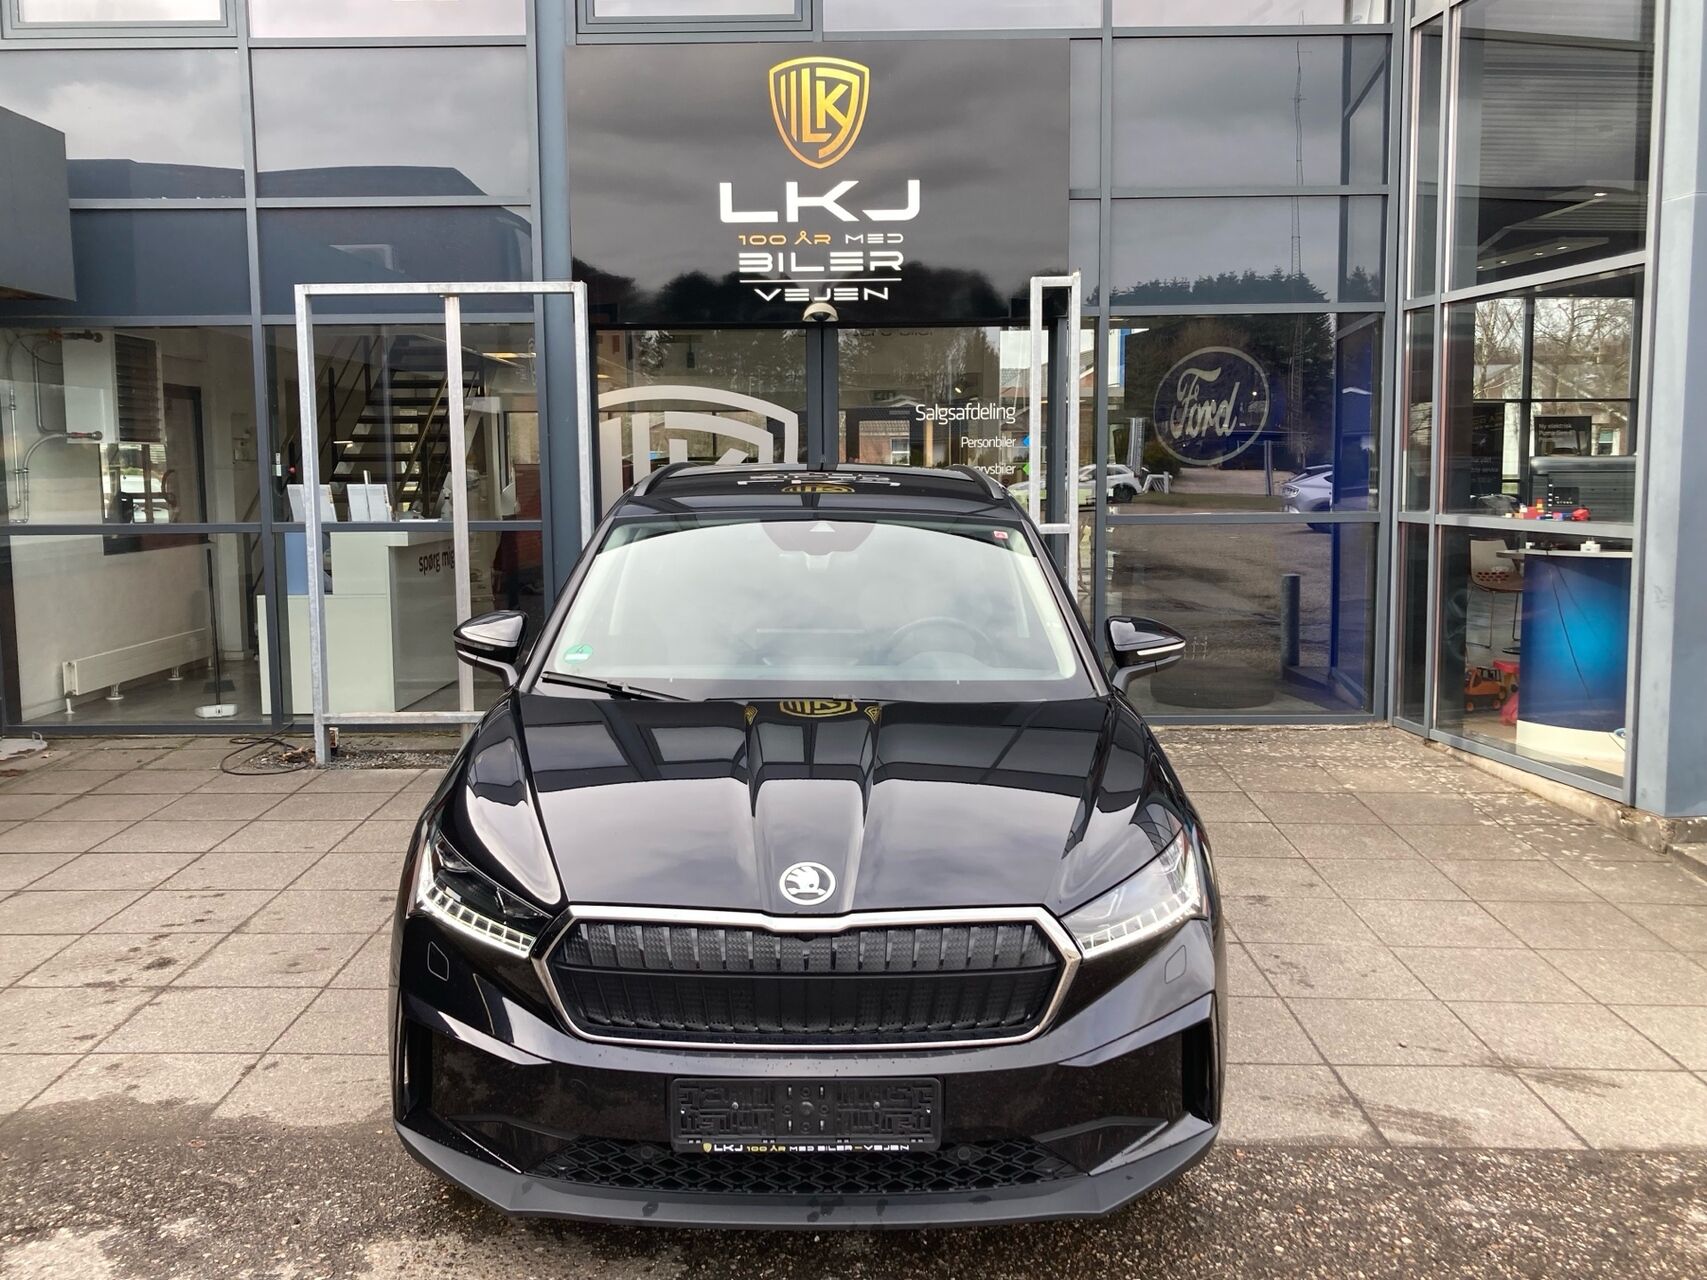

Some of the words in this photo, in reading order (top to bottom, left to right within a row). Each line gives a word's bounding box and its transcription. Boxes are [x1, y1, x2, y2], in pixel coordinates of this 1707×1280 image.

[719, 179, 921, 224] LKJ
[738, 234, 787, 246] 100
[794, 230, 832, 245] ÅR
[845, 233, 904, 245] MED
[738, 251, 904, 273] BILER
[753, 287, 889, 302] VEJEN
[915, 402, 1016, 425] Salgsafdeling
[1169, 366, 1241, 440] Ford
[961, 435, 1017, 448] Personbiler
[418, 552, 441, 576] spørg
[713, 1144, 743, 1152] LKJ
